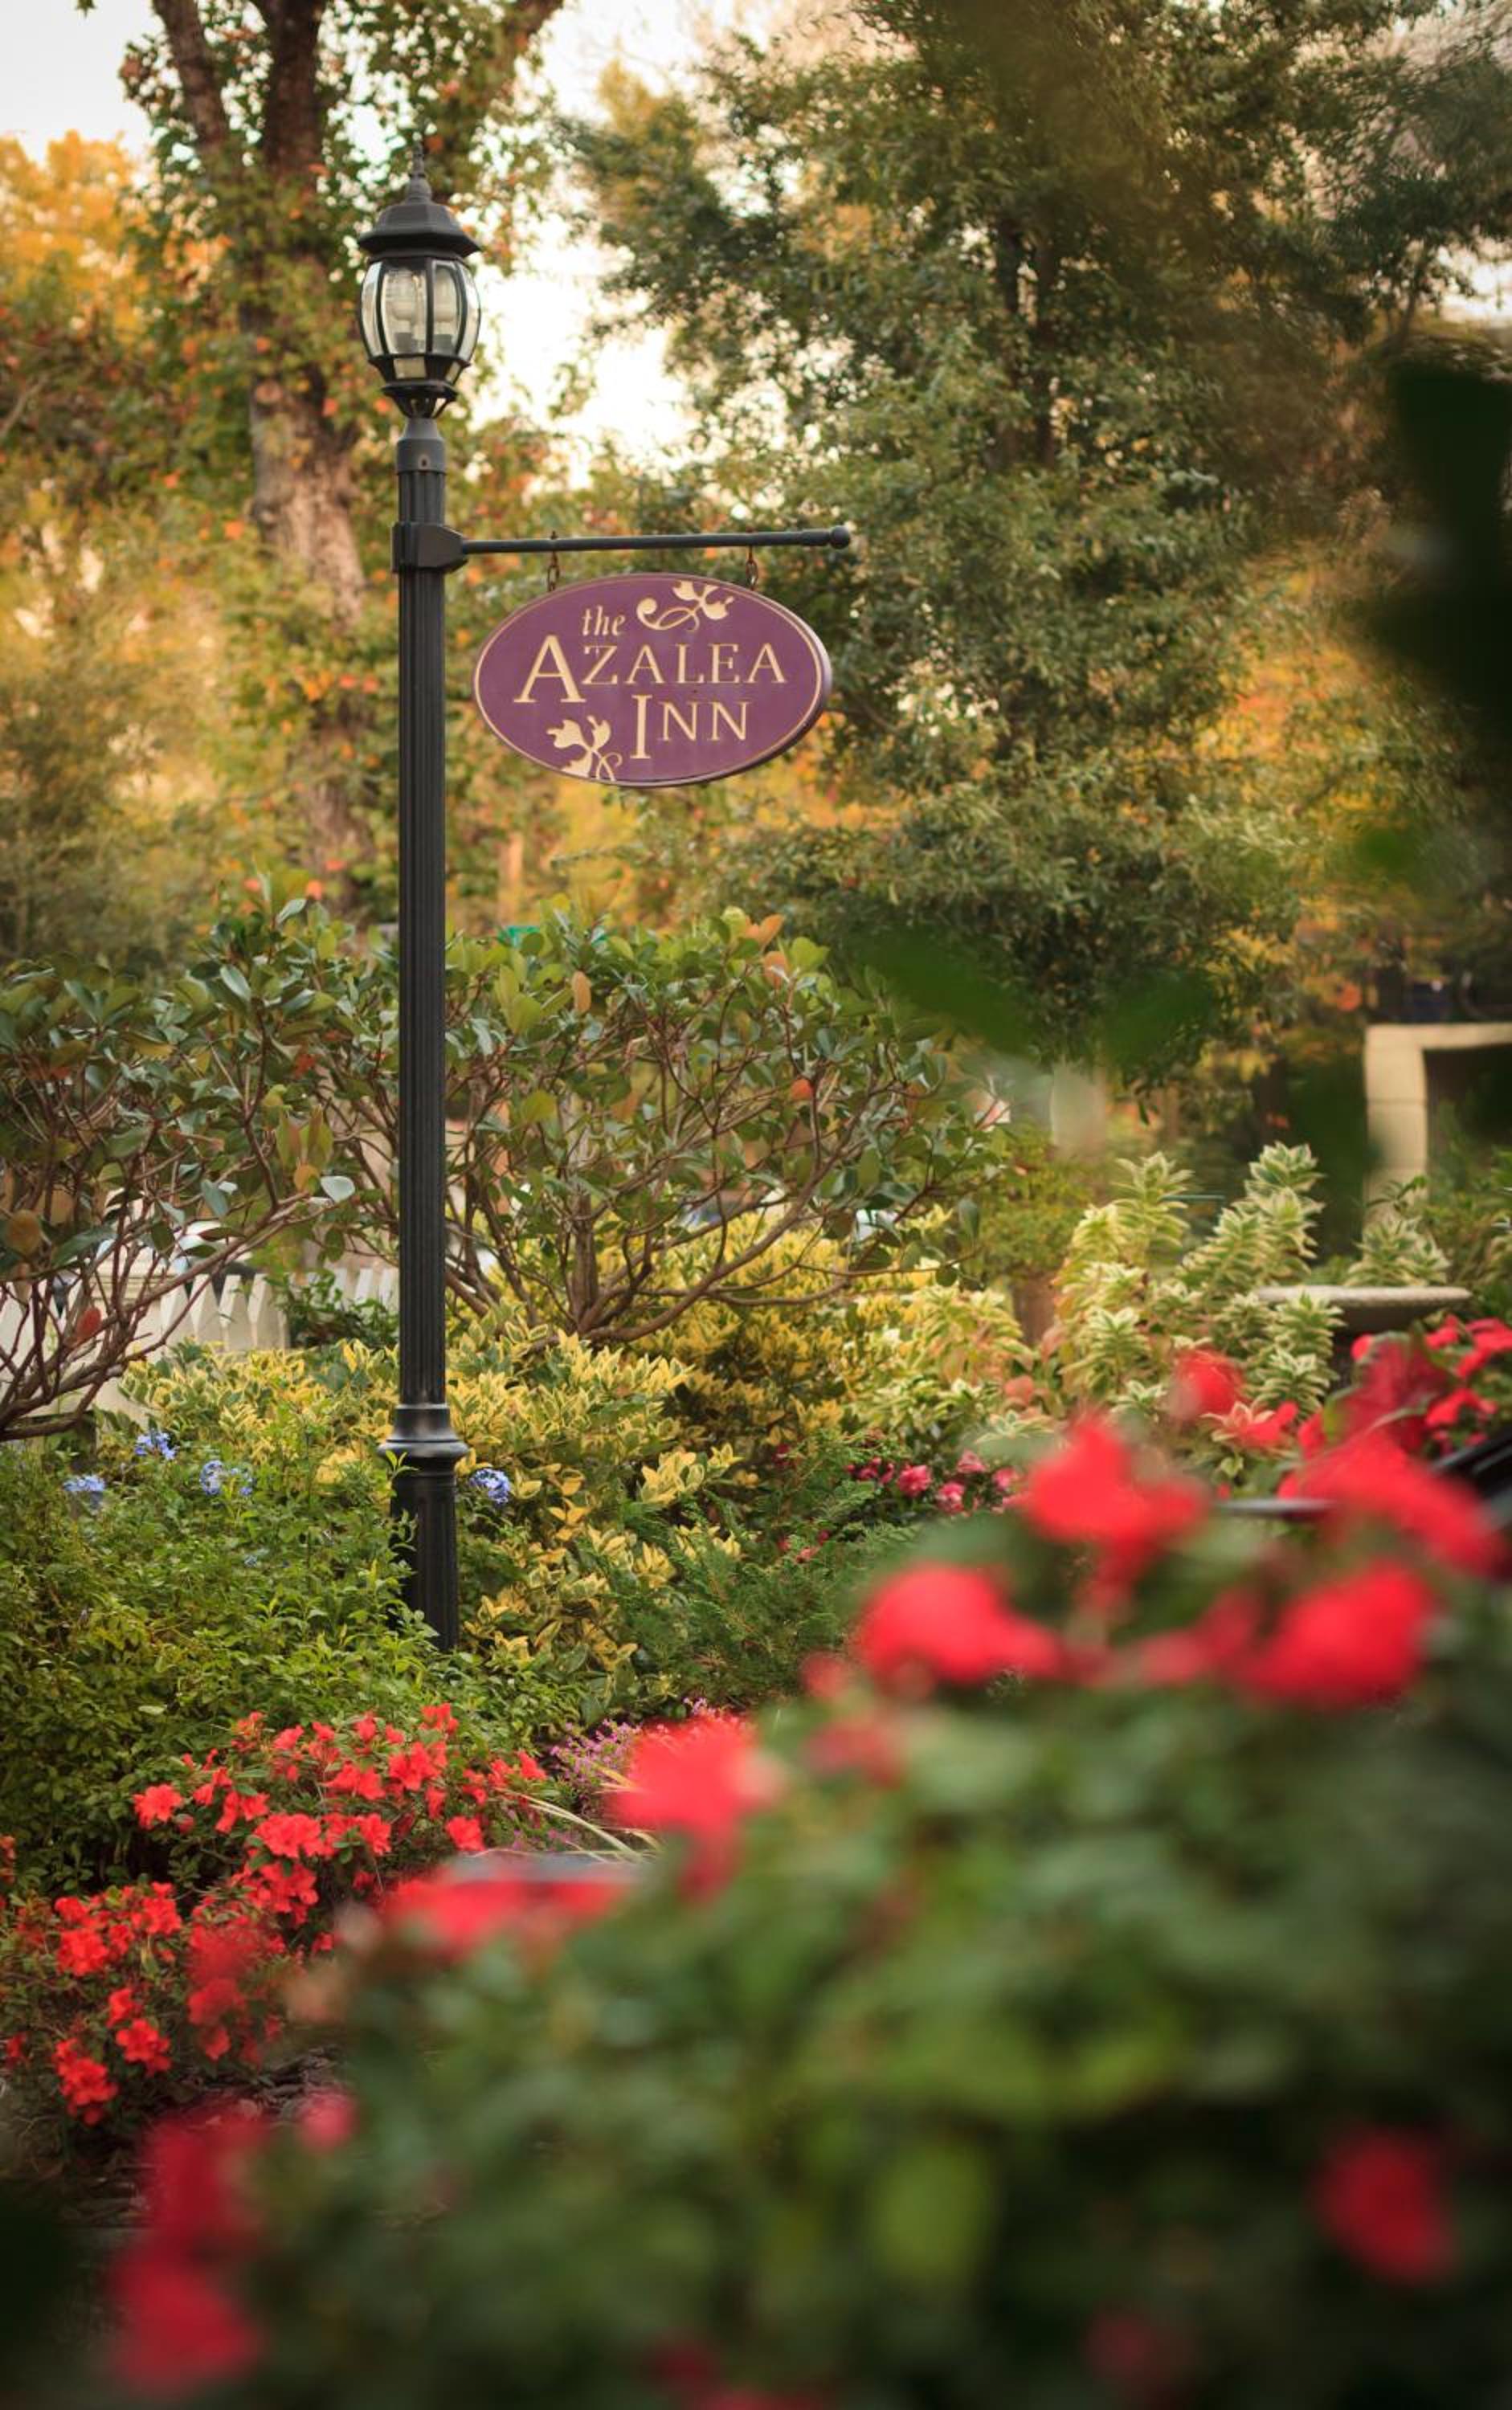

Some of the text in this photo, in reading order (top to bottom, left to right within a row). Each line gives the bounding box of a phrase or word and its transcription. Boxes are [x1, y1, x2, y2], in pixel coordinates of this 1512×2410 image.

[582, 606, 626, 635] the
[513, 635, 786, 703] AZALEA
[630, 695, 749, 759] INN
